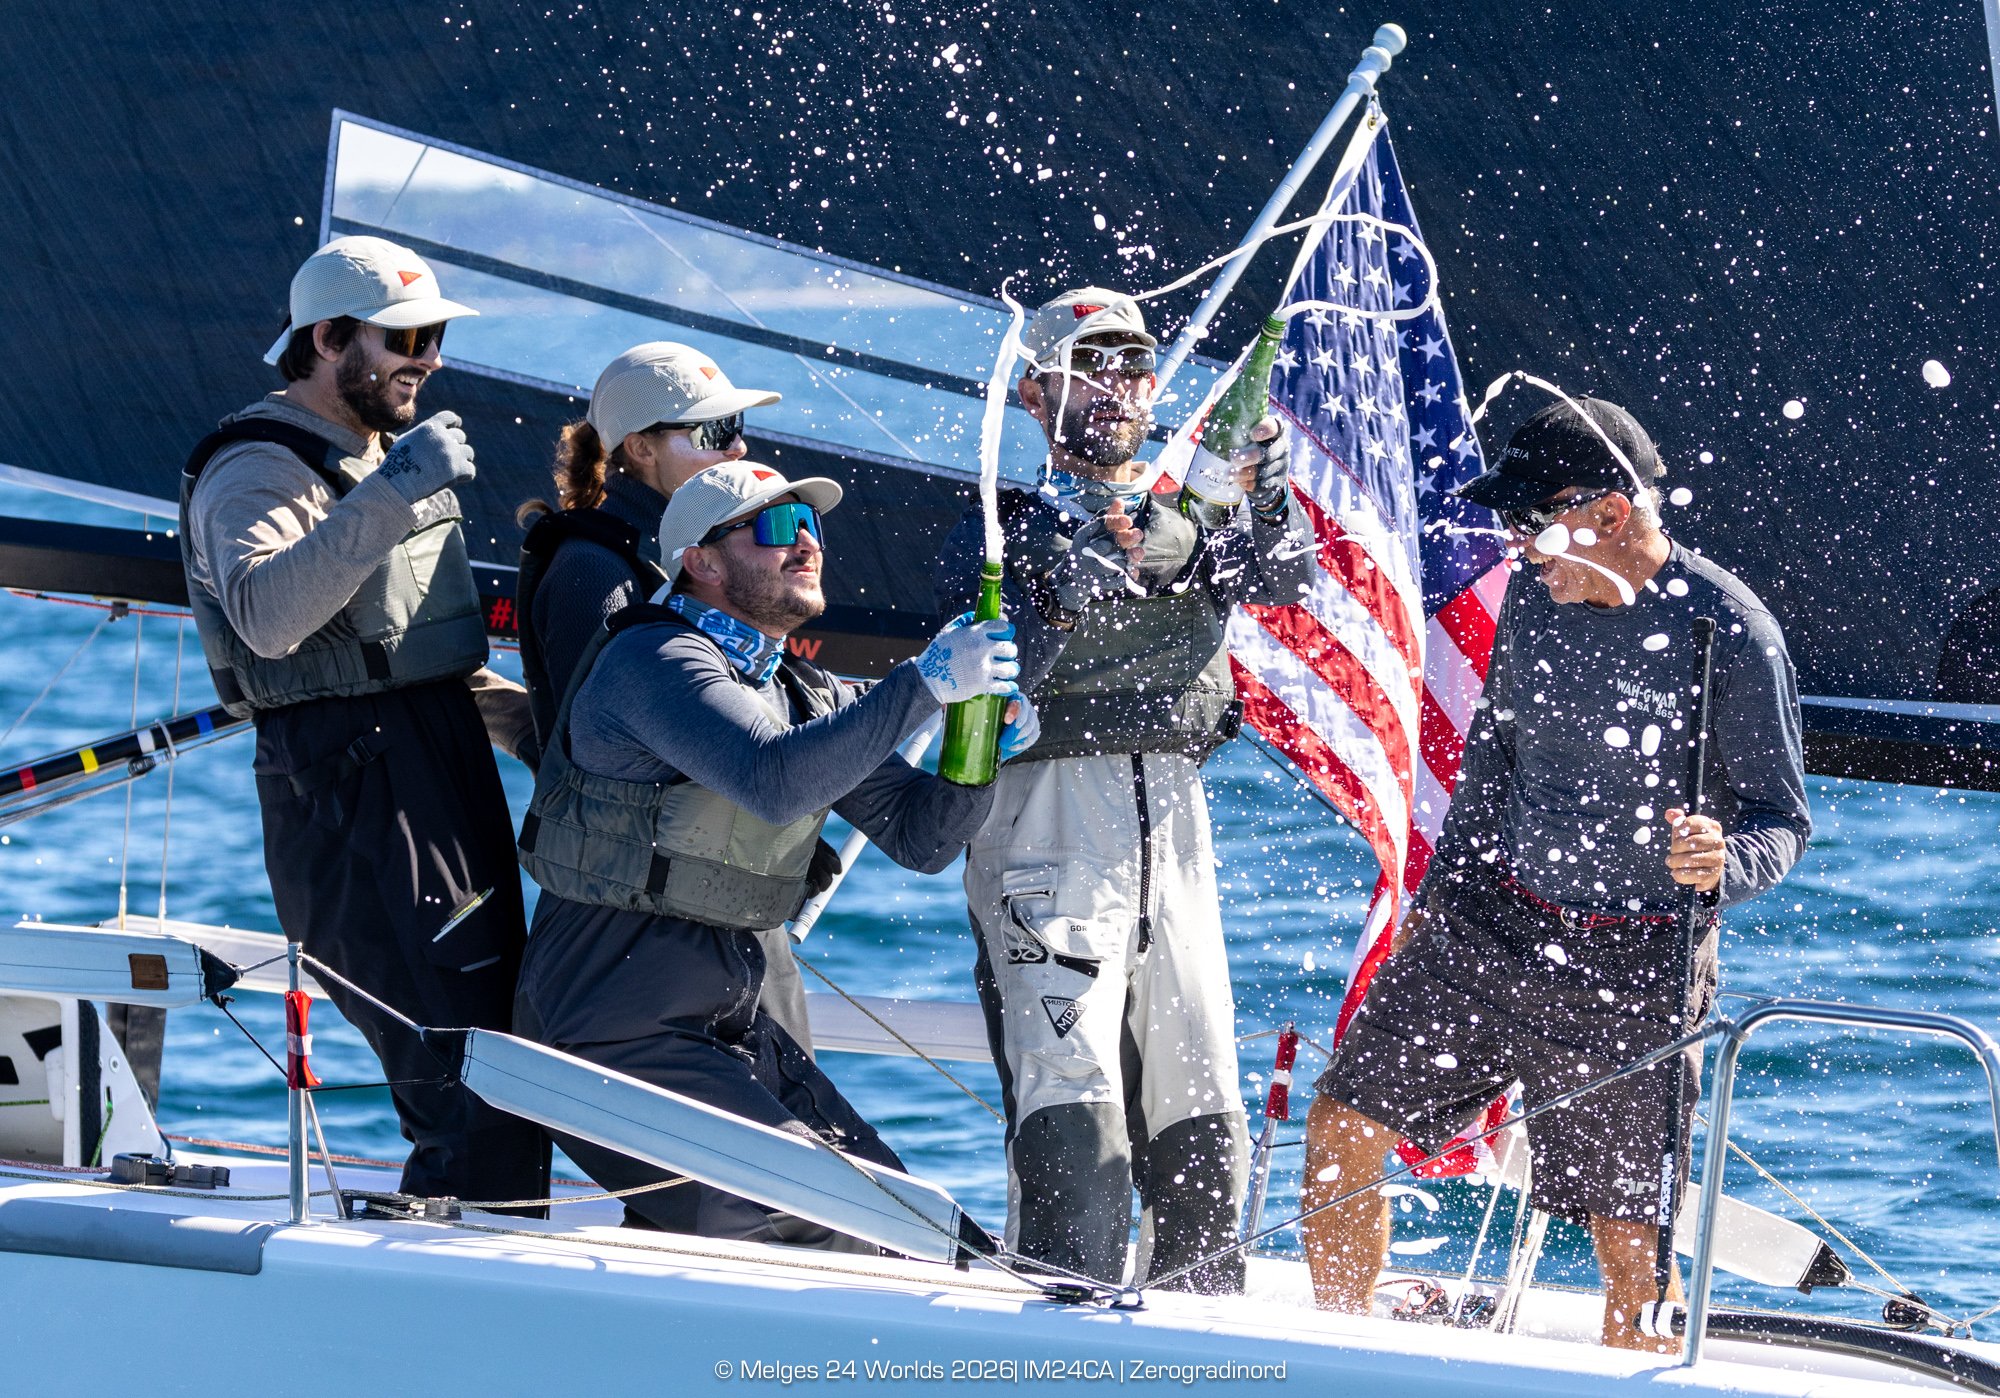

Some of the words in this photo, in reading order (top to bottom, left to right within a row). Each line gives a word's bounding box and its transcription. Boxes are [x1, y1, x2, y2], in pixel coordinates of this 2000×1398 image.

[1617, 678, 1677, 710] WAH-GWAN
[1655, 707, 1674, 719] 865
[1056, 1002, 1085, 1032] MPX
